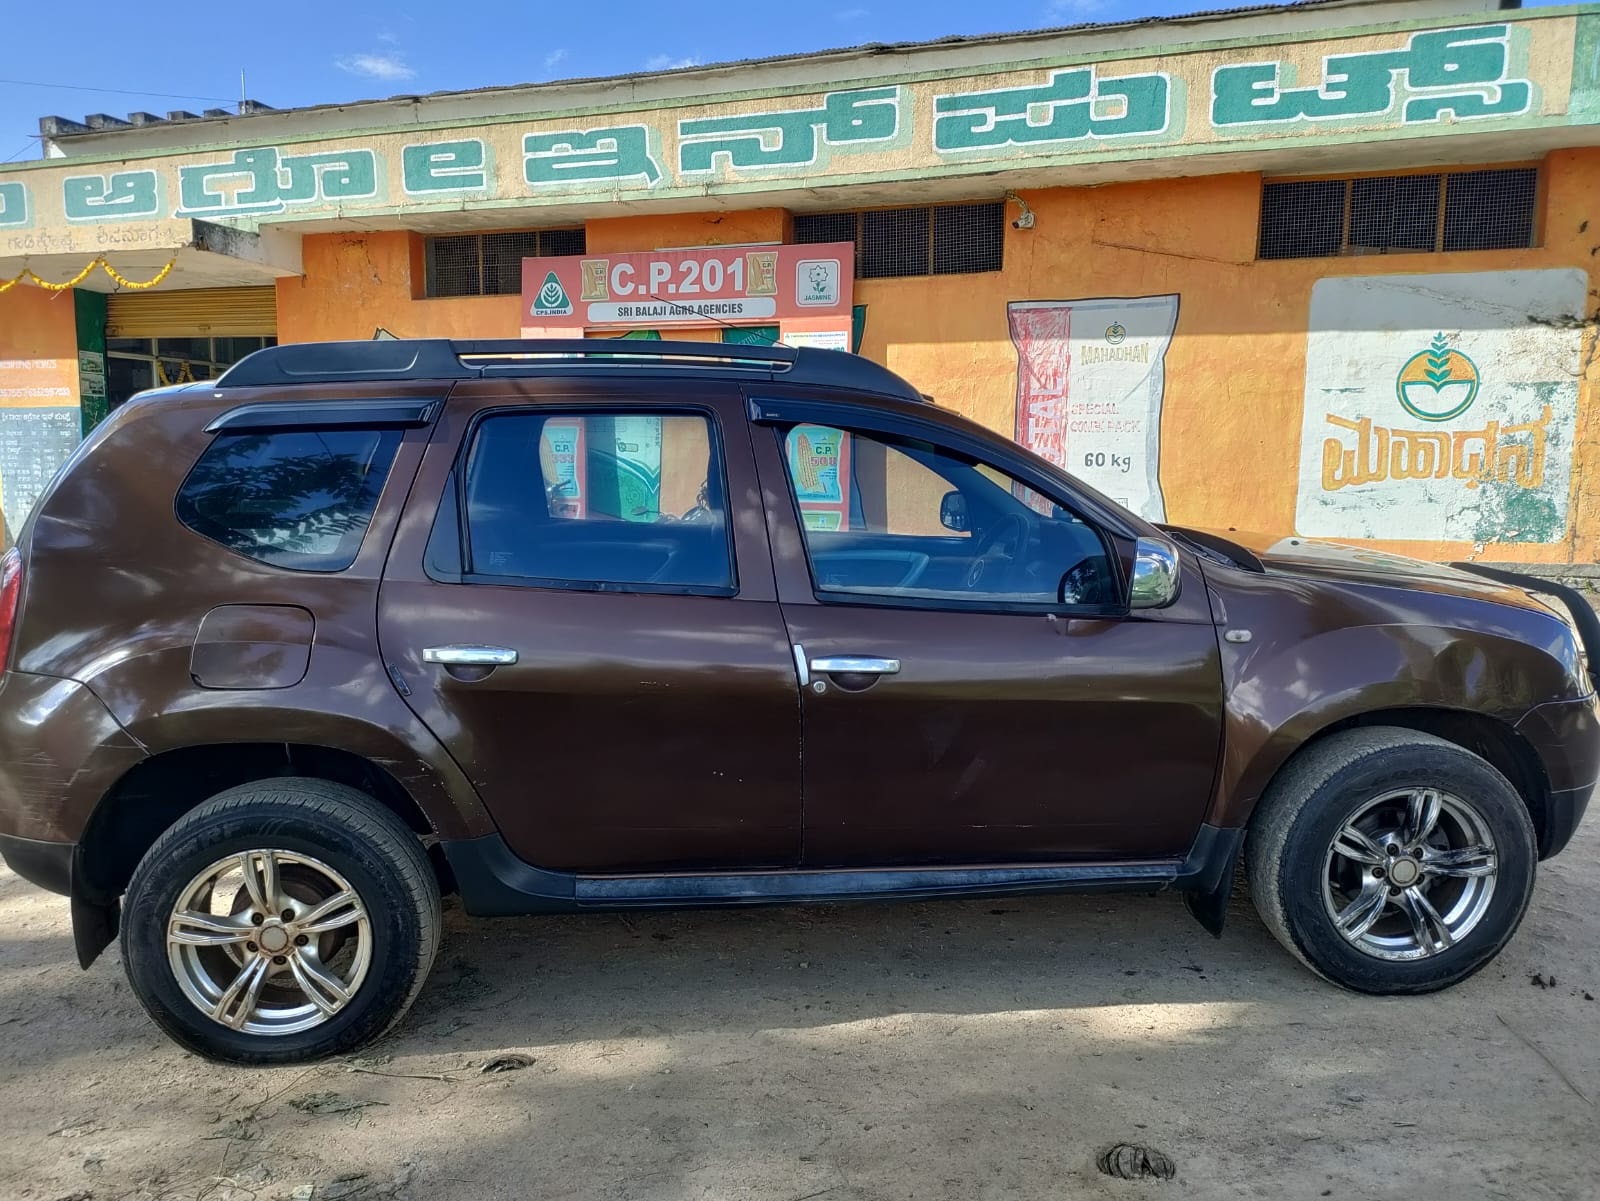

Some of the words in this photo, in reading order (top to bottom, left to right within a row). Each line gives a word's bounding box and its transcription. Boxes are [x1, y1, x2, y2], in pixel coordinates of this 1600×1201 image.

[611, 257, 744, 296] C.P.201
[617, 306, 633, 317] SRI
[635, 305, 667, 317] BALAJI
[669, 304, 694, 316] AGRO
[697, 302, 743, 315] AGENCIES
[1080, 342, 1149, 366] MAHADHAN
[1071, 402, 1119, 415] SPECIAL
[1107, 420, 1142, 433] PACK
[815, 446, 832, 455] C.P.
[1084, 452, 1106, 468] 60
[1111, 453, 1132, 473] kg
